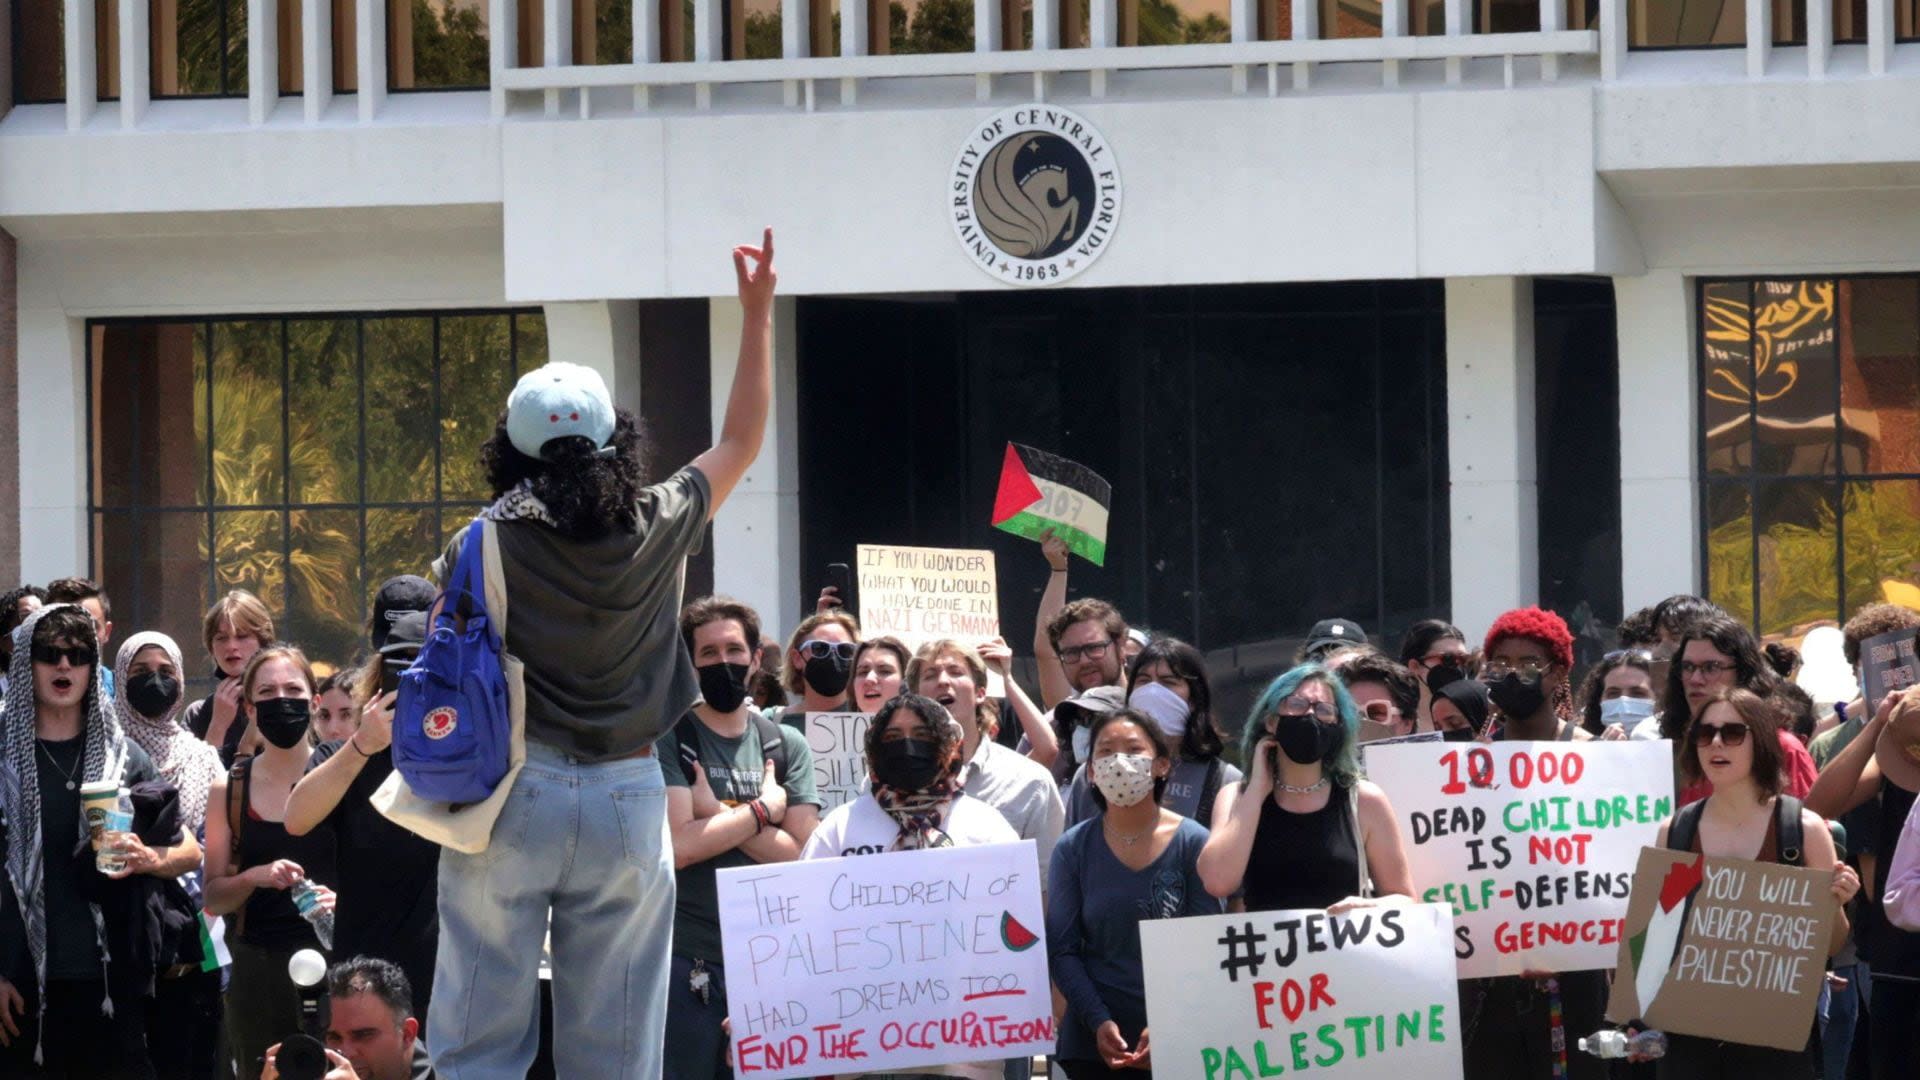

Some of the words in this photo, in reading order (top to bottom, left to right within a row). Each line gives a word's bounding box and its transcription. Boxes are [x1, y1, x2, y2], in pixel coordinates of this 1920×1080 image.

[954, 144, 996, 267] UNIVERSITY
[981, 118, 1003, 142] OF
[1015, 109, 1104, 161] CENTRAL
[1078, 170, 1115, 258] FLORIDA
[1015, 264, 1059, 280] 1963
[864, 548, 886, 566] IF
[893, 551, 918, 569] YOU
[923, 553, 986, 571] WONDER
[862, 573, 905, 590] WHAT
[911, 577, 937, 593] YOU
[941, 579, 991, 594] WOULD
[882, 593, 923, 609] HAVE
[928, 597, 962, 611] DONE
[968, 598, 992, 614] IN
[867, 608, 912, 632] NAZI
[922, 610, 999, 635] GERMANY
[811, 714, 876, 754] STO
[814, 757, 866, 788] SILE
[1410, 805, 1486, 845] DEAD
[1502, 795, 1671, 833] CHILDREN
[1465, 835, 1512, 871] IS
[1528, 833, 1592, 865] NOT
[737, 874, 801, 927] THE
[829, 872, 970, 912] CHILDREN
[988, 873, 1020, 896] OF
[1423, 870, 1632, 916] SELF-DEFENS
[1705, 864, 1747, 901] YOU
[1759, 873, 1813, 907] WILL
[748, 914, 999, 986] PALESTINE
[1217, 909, 1405, 982] #JEWS
[1690, 906, 1753, 943] NEVER
[1754, 912, 1819, 950] ERASE
[1675, 945, 1809, 995] PALESTINE
[744, 1000, 807, 1037] HAD
[831, 977, 950, 1020] DREAMS
[960, 973, 1018, 995] TOO
[1252, 973, 1336, 1029] FOR
[737, 1034, 809, 1074] END
[812, 1023, 868, 1060] THE
[879, 1011, 1054, 1051] OCCUPATION
[1200, 1004, 1446, 1080] PALESTINE
